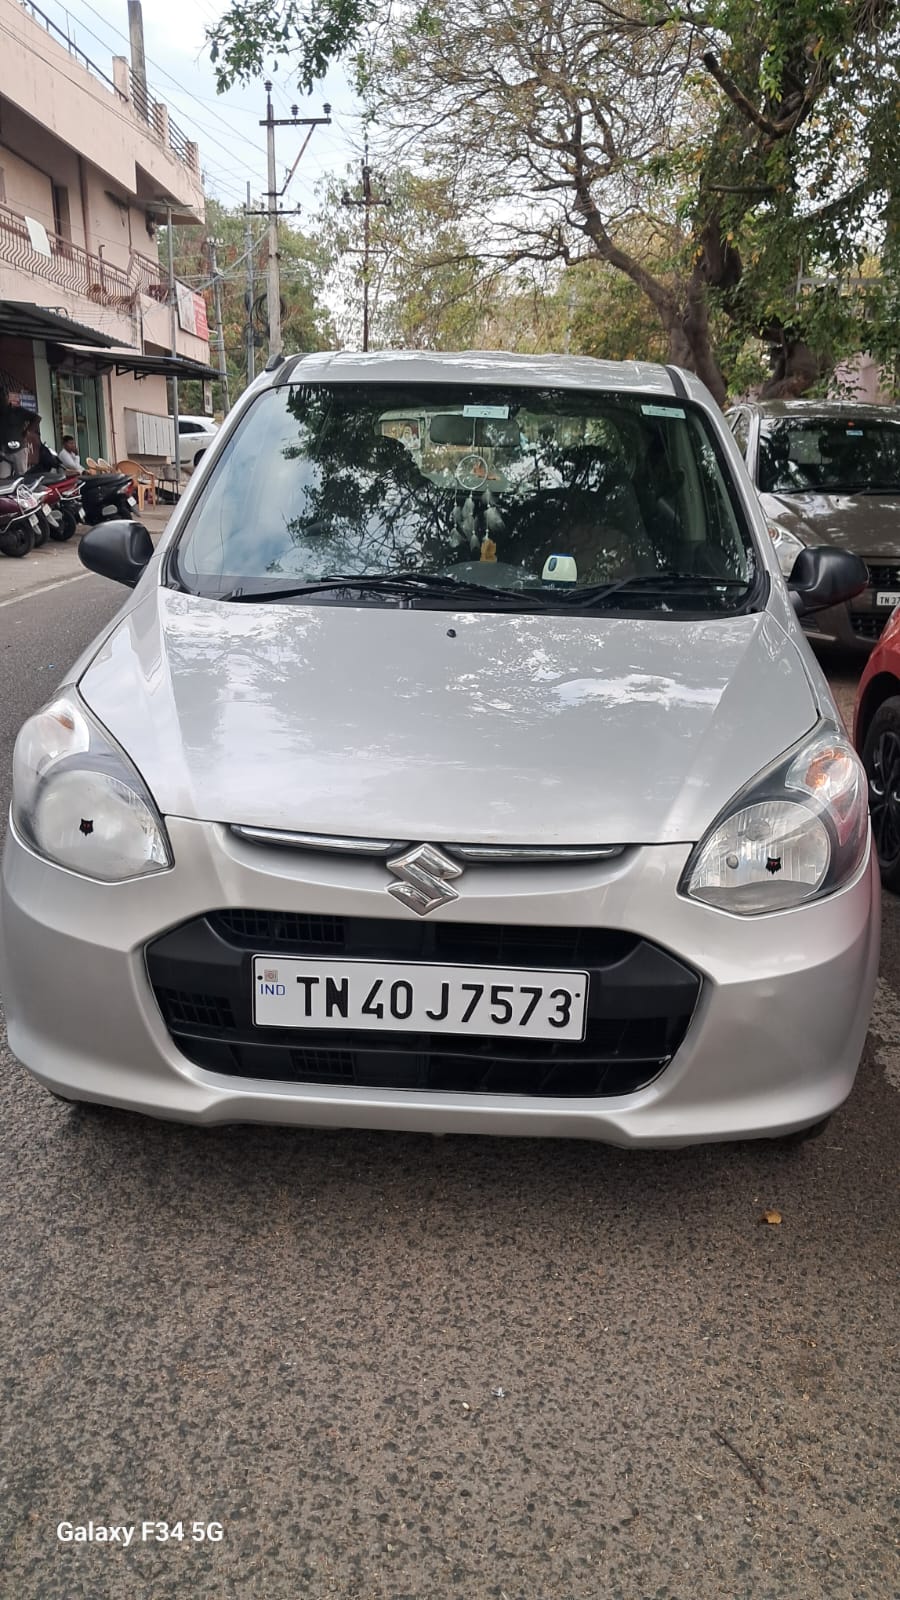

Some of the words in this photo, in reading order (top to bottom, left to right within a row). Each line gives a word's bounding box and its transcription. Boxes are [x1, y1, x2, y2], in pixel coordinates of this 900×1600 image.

[880, 596, 890, 605] TN
[260, 983, 286, 996] IND
[296, 975, 349, 1018] TN
[361, 979, 414, 1020] 40
[461, 983, 572, 1028] 7573
